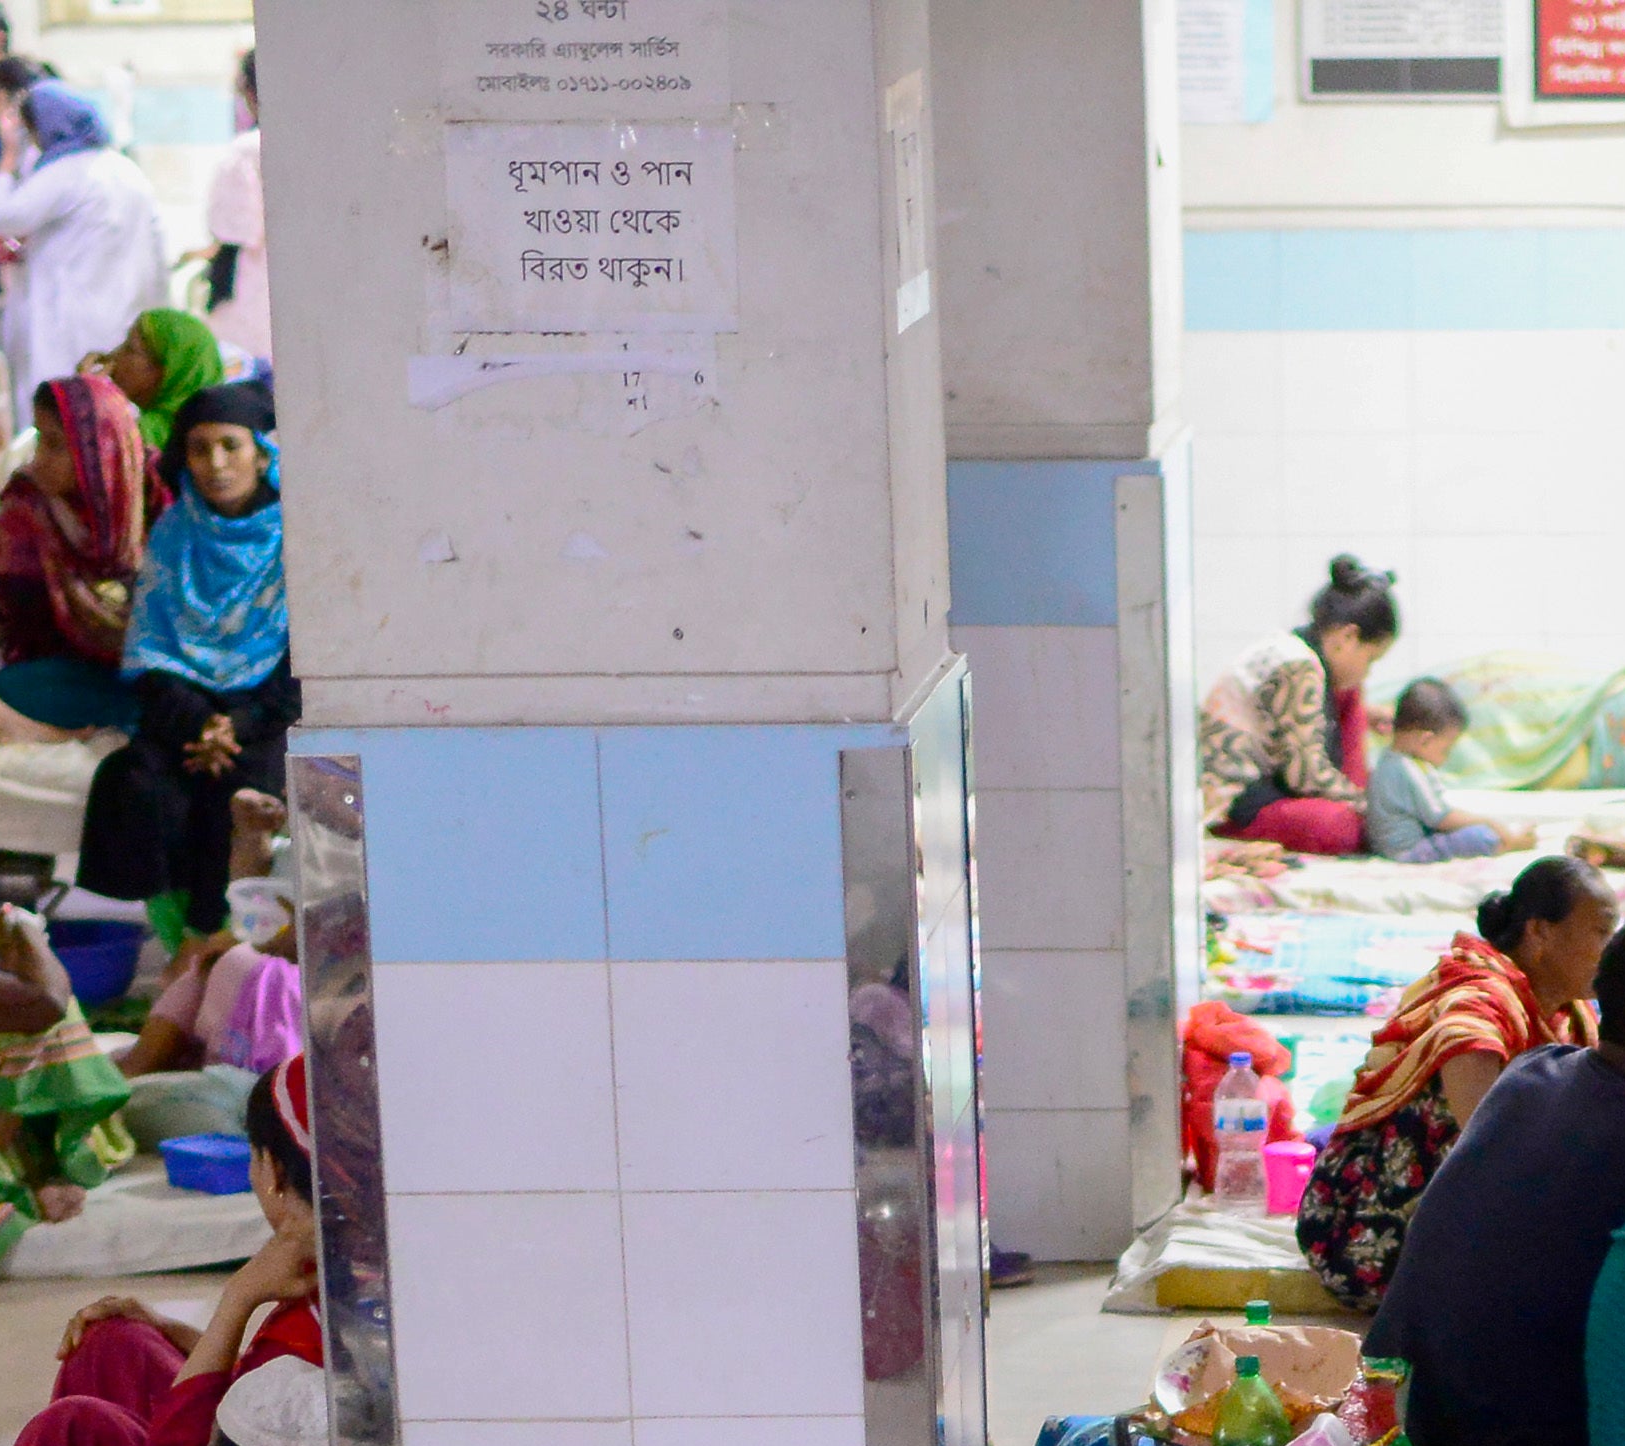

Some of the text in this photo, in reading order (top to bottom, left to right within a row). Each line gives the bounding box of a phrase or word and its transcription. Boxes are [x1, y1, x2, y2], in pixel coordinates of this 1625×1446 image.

[508, 160, 694, 193] ধূমপান ও পান
[523, 209, 682, 234] খাওয়া থেকে
[521, 249, 589, 281] বিরত
